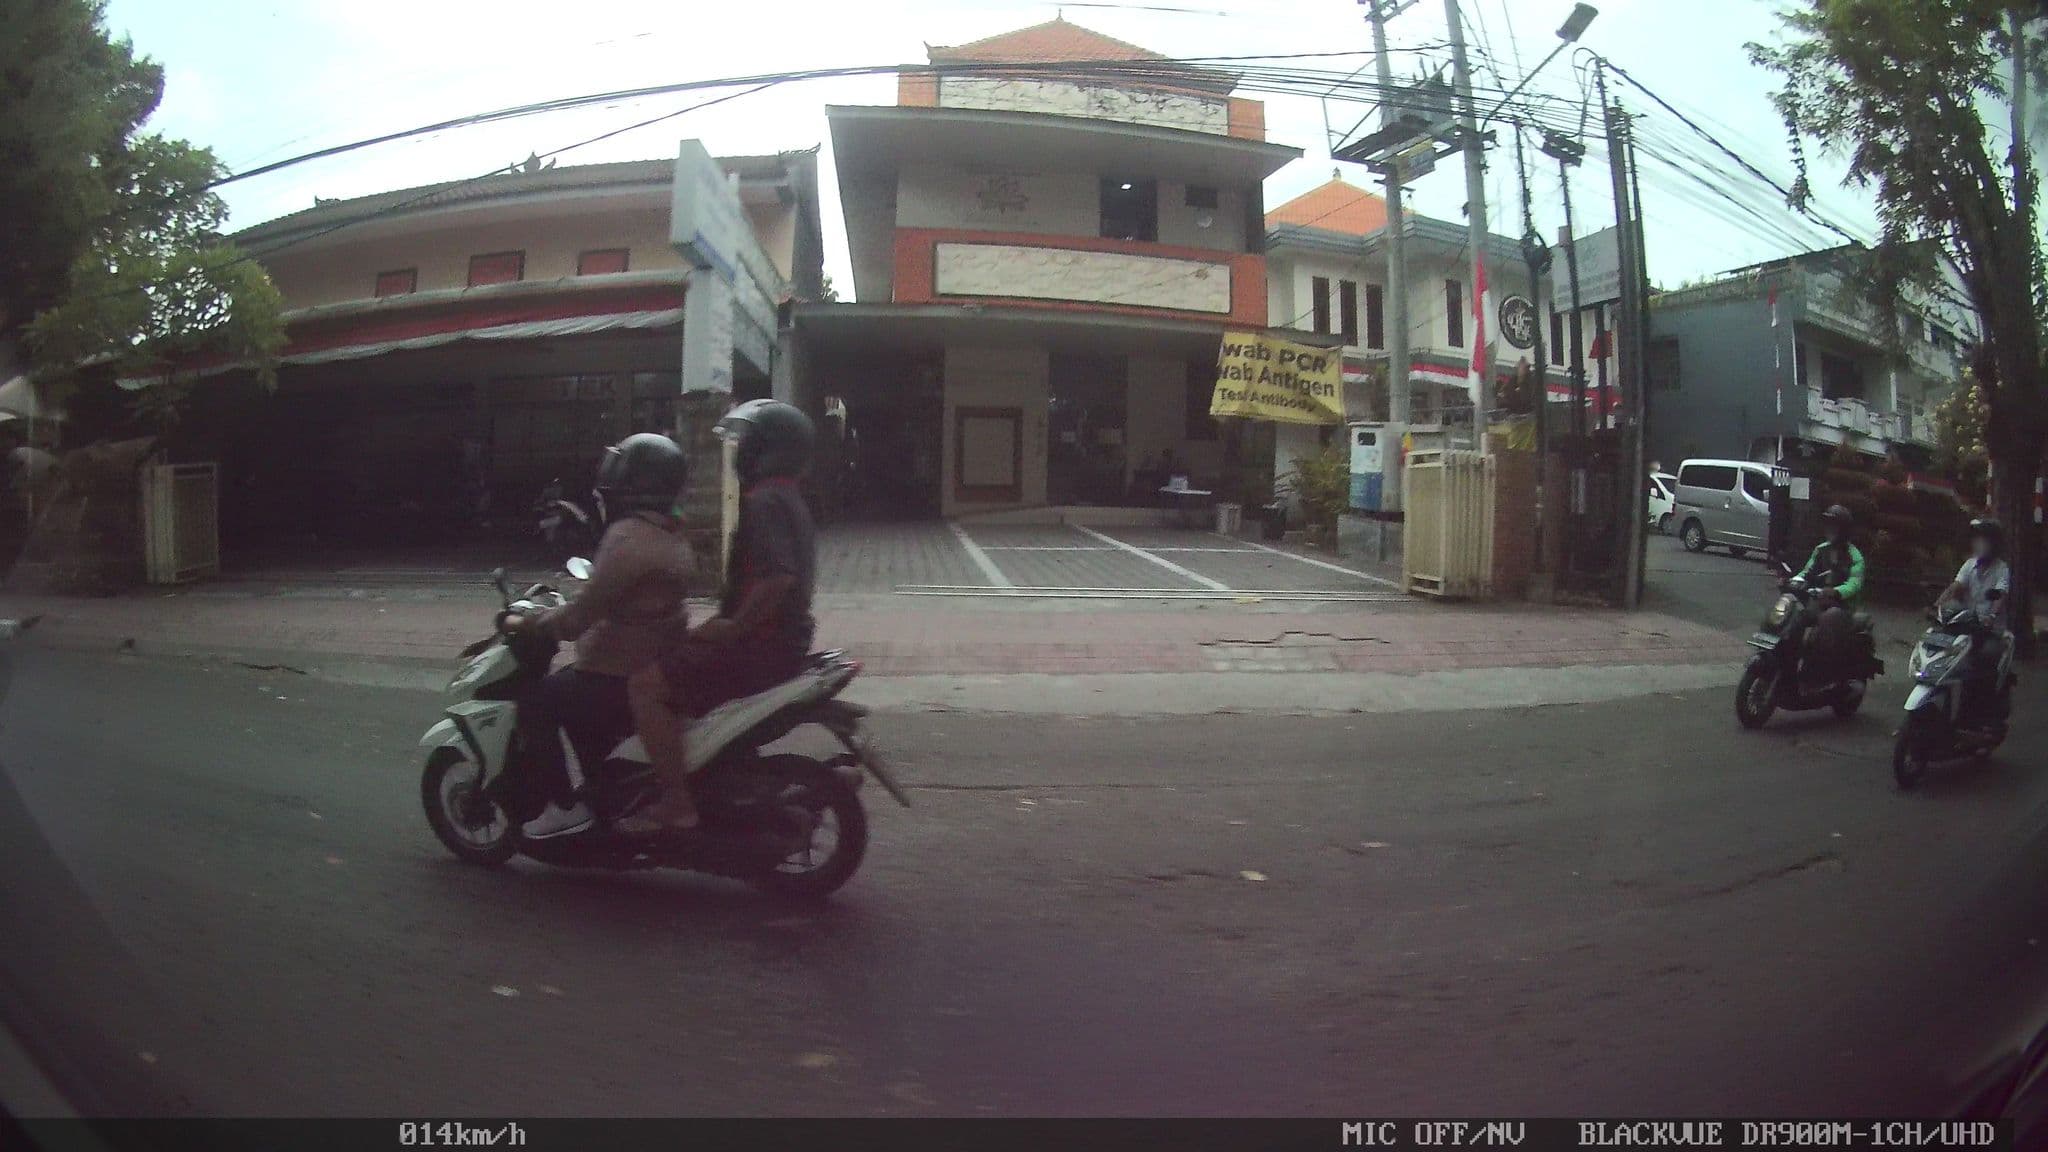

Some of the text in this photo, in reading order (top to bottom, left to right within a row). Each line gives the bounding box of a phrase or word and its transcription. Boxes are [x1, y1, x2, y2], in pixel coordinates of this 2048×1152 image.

[1278, 347, 1328, 375] PCR
[1218, 387, 1248, 402] Test
[1258, 365, 1335, 397] Antigen
